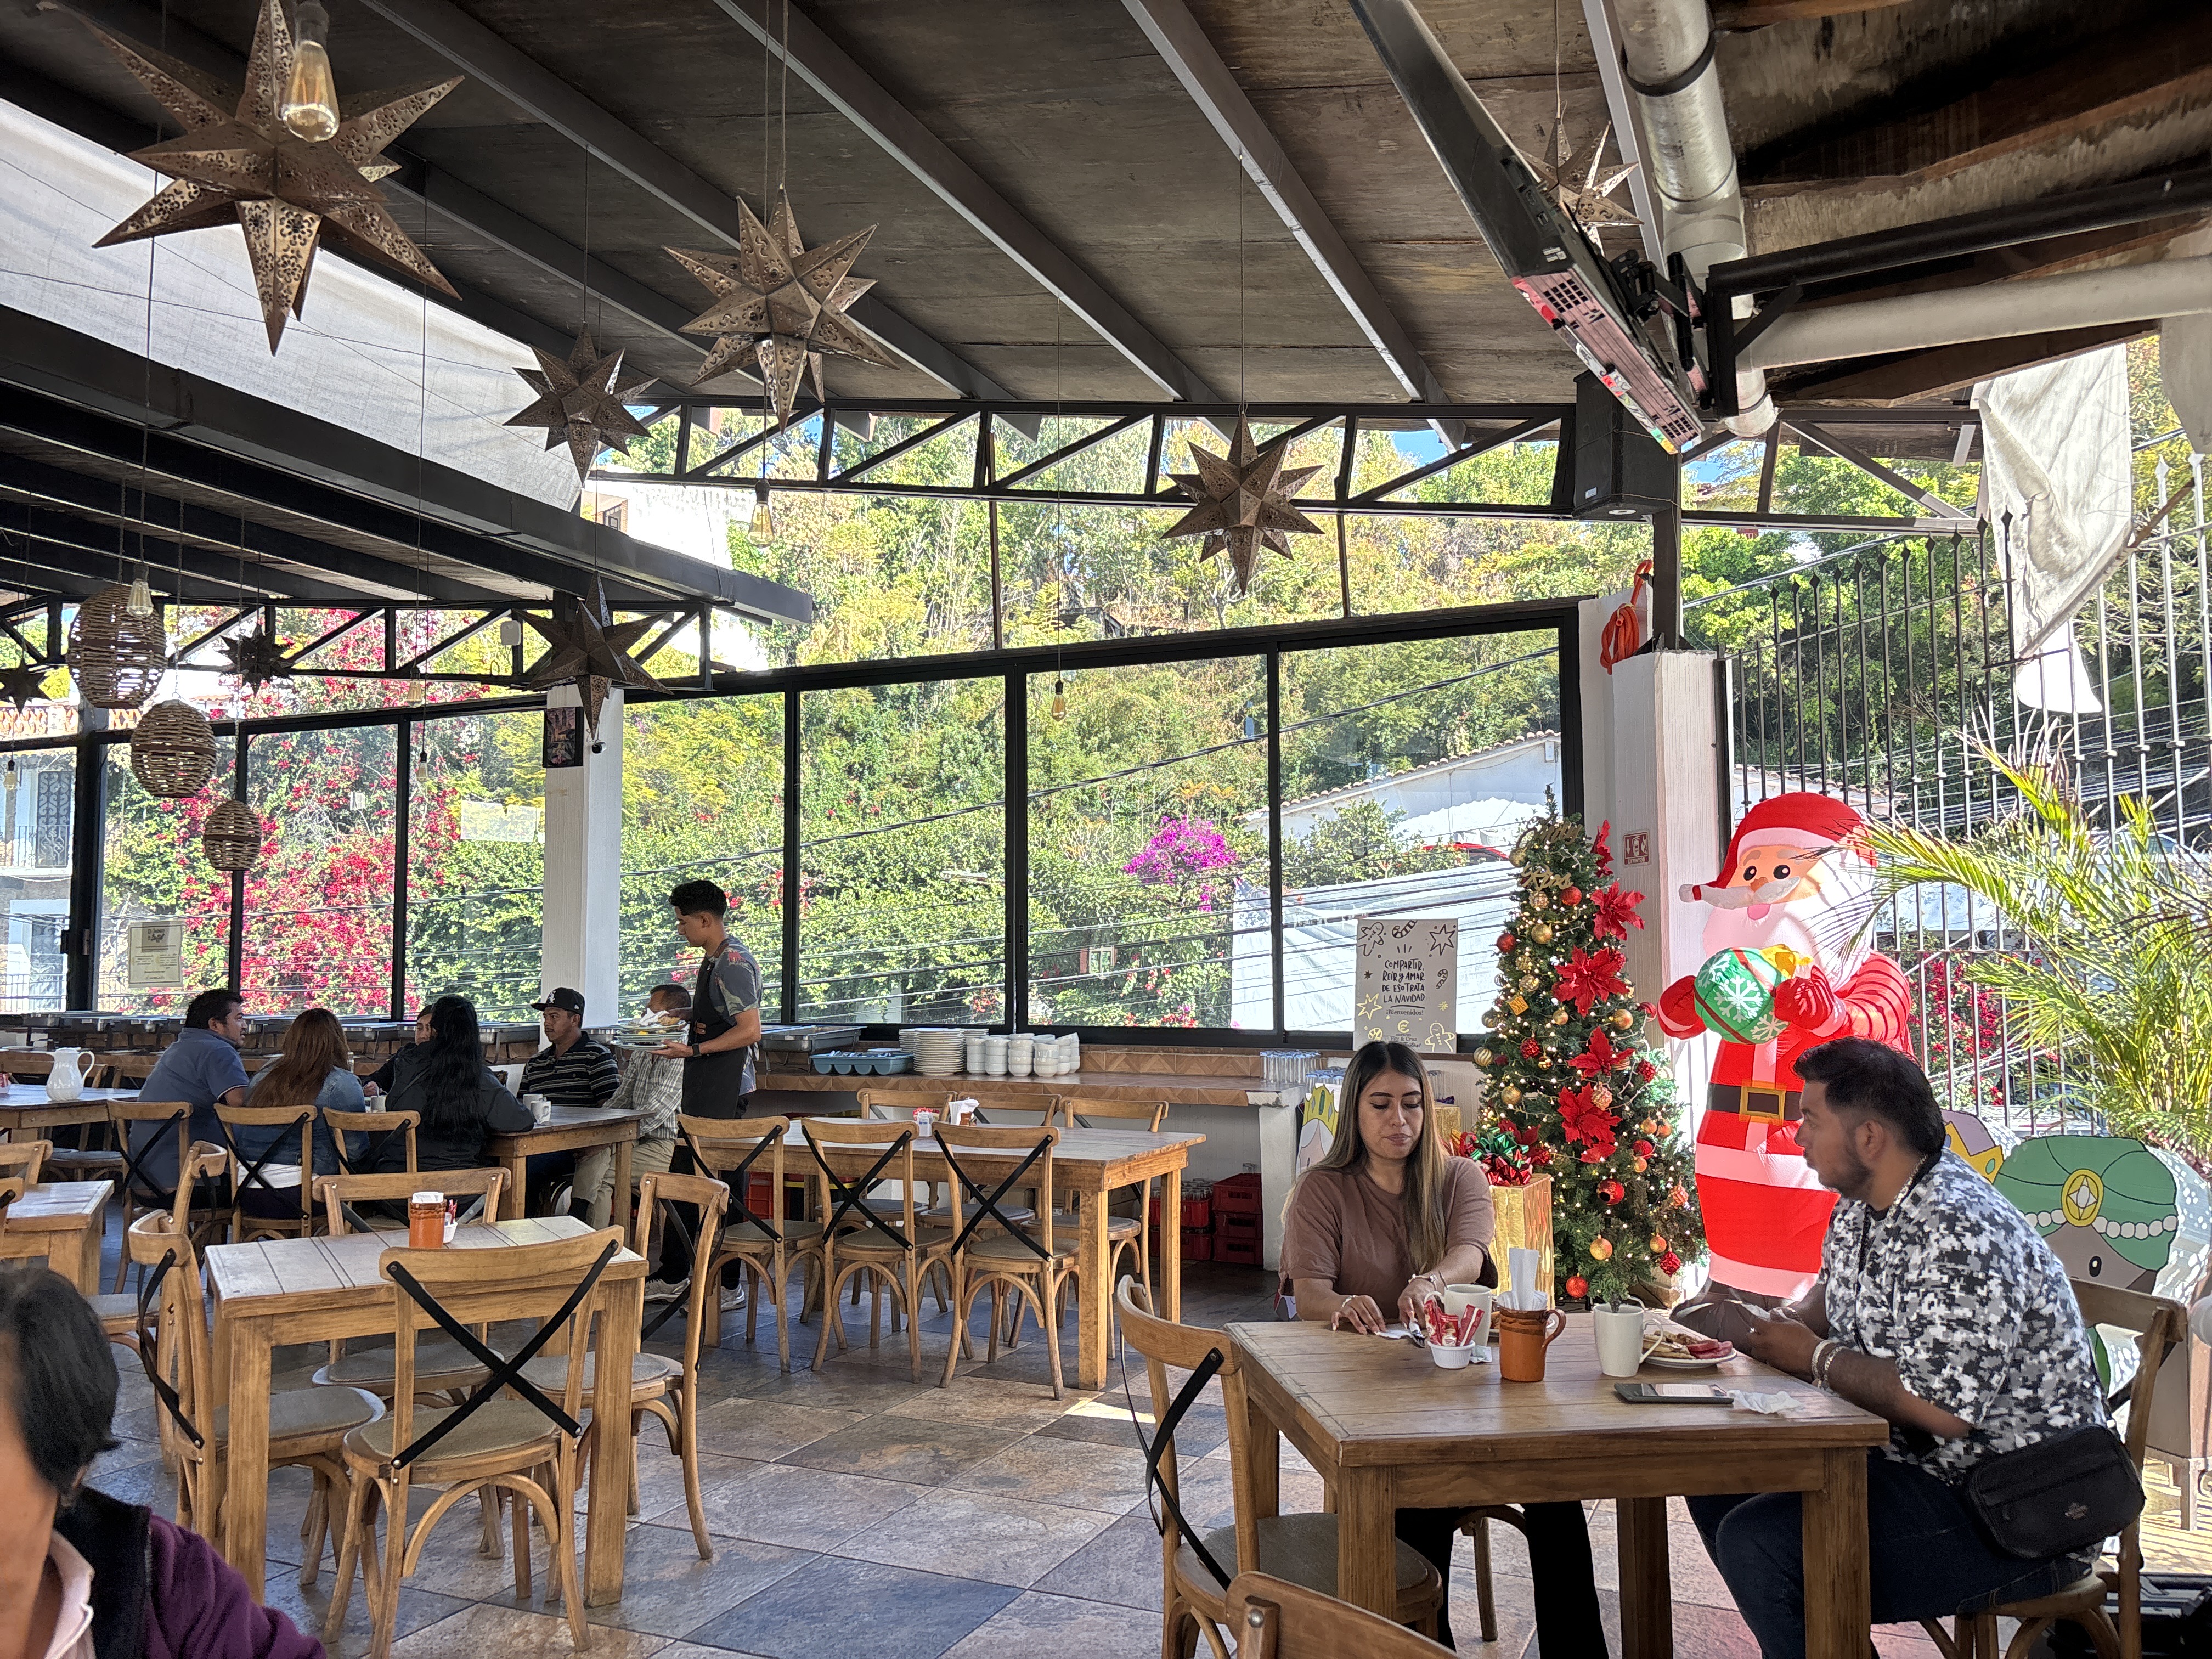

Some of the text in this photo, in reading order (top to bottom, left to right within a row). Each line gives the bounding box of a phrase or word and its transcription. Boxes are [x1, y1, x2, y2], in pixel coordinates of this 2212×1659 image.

[1382, 970, 1397, 981] REÍR
[1405, 971, 1425, 981] AMAR
[1393, 984, 1404, 992] ESO
[1404, 983, 1425, 992] TRATA
[1383, 992, 1425, 1003] LA NAVIDAD
